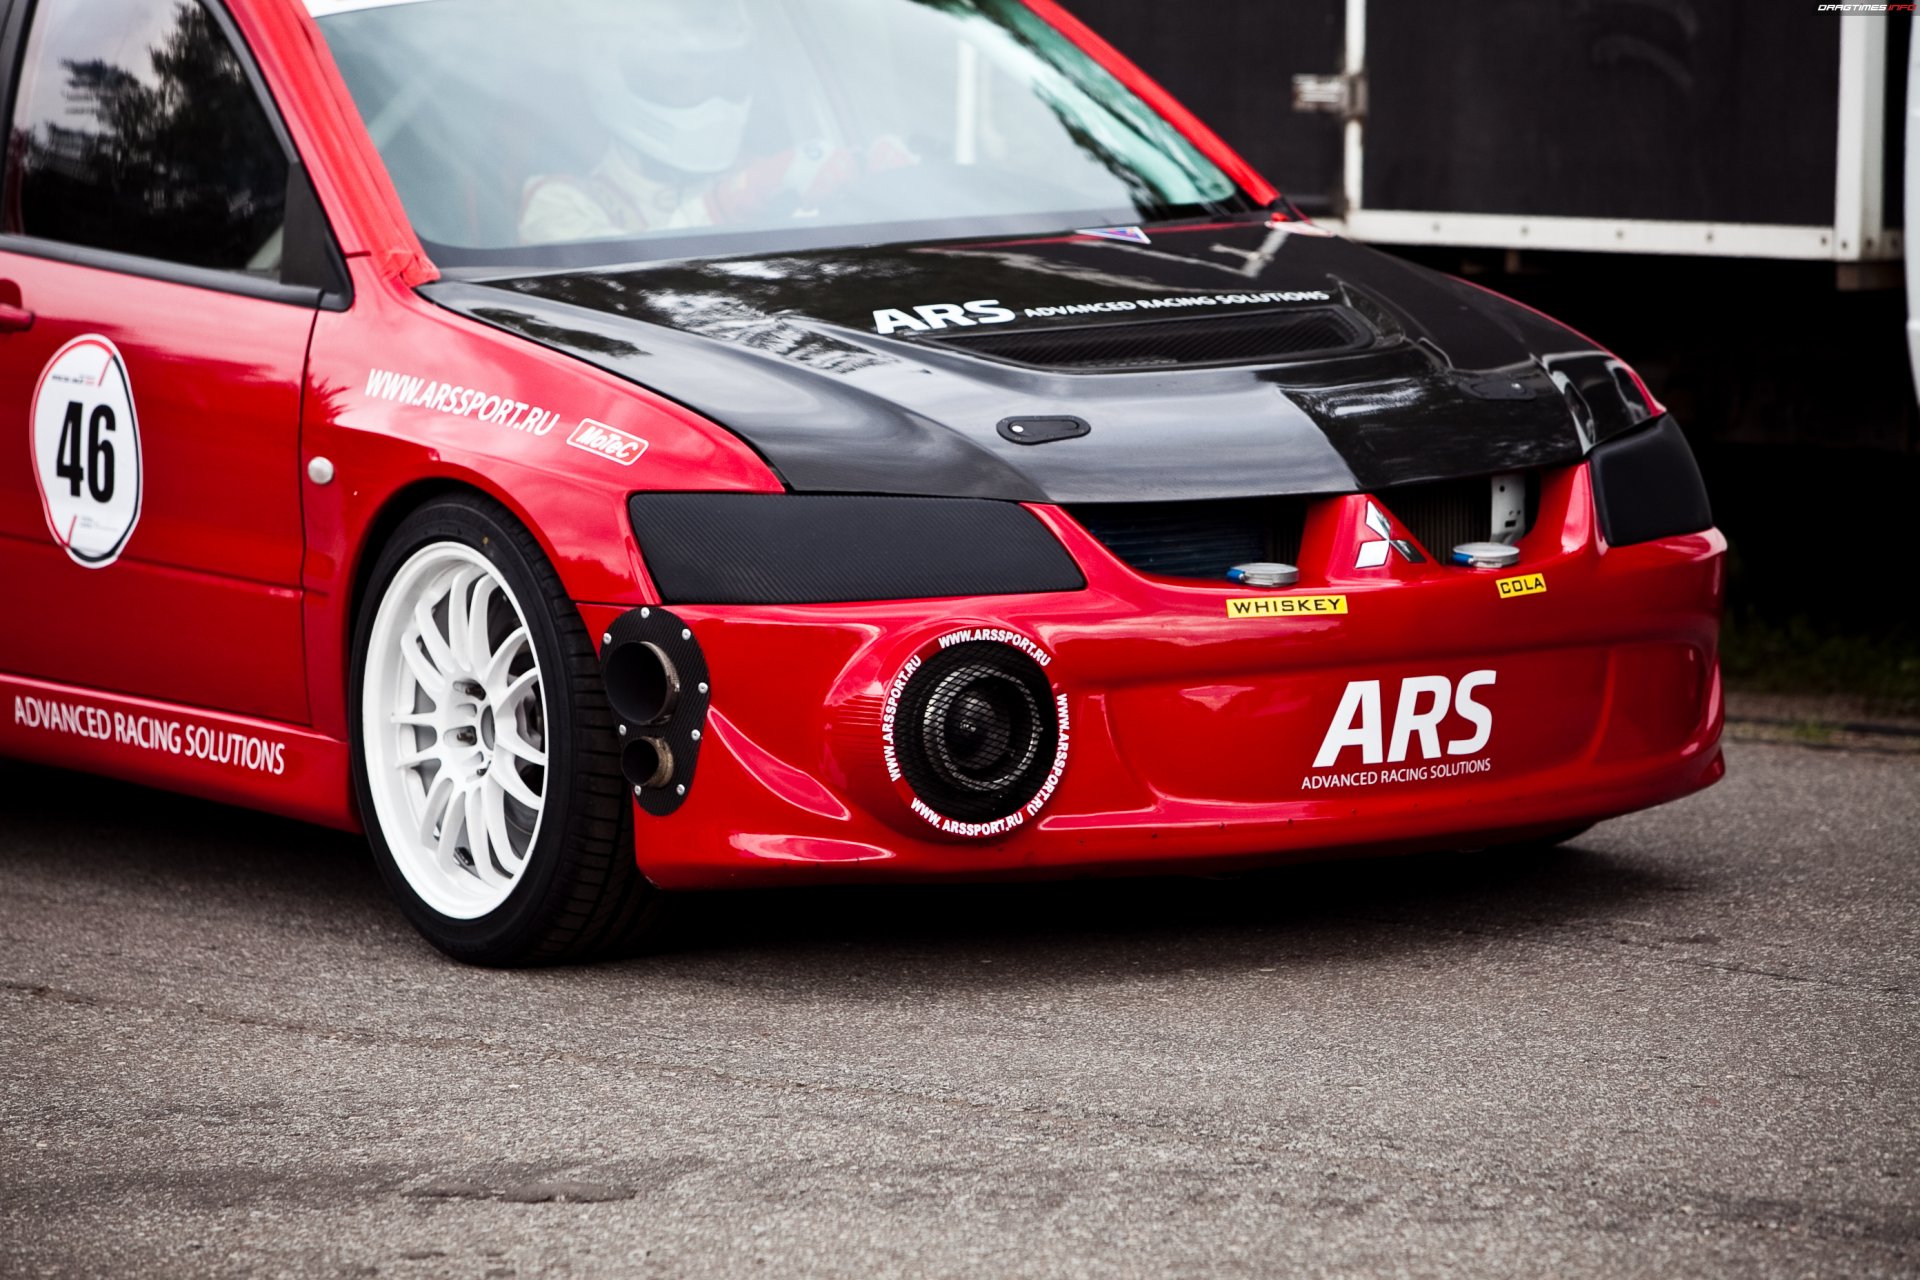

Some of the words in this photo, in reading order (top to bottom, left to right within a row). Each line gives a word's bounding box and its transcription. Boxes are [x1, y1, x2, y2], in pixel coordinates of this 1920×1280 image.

[872, 299, 1016, 335] ARS
[1023, 300, 1137, 319] ADVANCED
[1136, 295, 1217, 310] RACING
[1214, 290, 1330, 305] SOLUTIONS
[364, 367, 561, 437] WWW.ARSSPORT.RU
[56, 400, 117, 504] 46
[1232, 598, 1342, 614] WHISKEY
[1499, 577, 1545, 595] COLA
[937, 628, 1051, 667] WWW.ARSSPORT.RU
[14, 695, 112, 740] ADVANCED
[113, 711, 182, 754] RACING
[184, 724, 286, 775] SOLUTIONS
[881, 654, 923, 782] WWW.ARSSPORT.RU
[1311, 669, 1497, 768] ARS
[1026, 693, 1070, 816] WWW.ARSSPORT.RU
[1300, 770, 1378, 790] ADVANCED
[1380, 766, 1428, 784] RACING
[1430, 757, 1491, 778] SOLUTIONS
